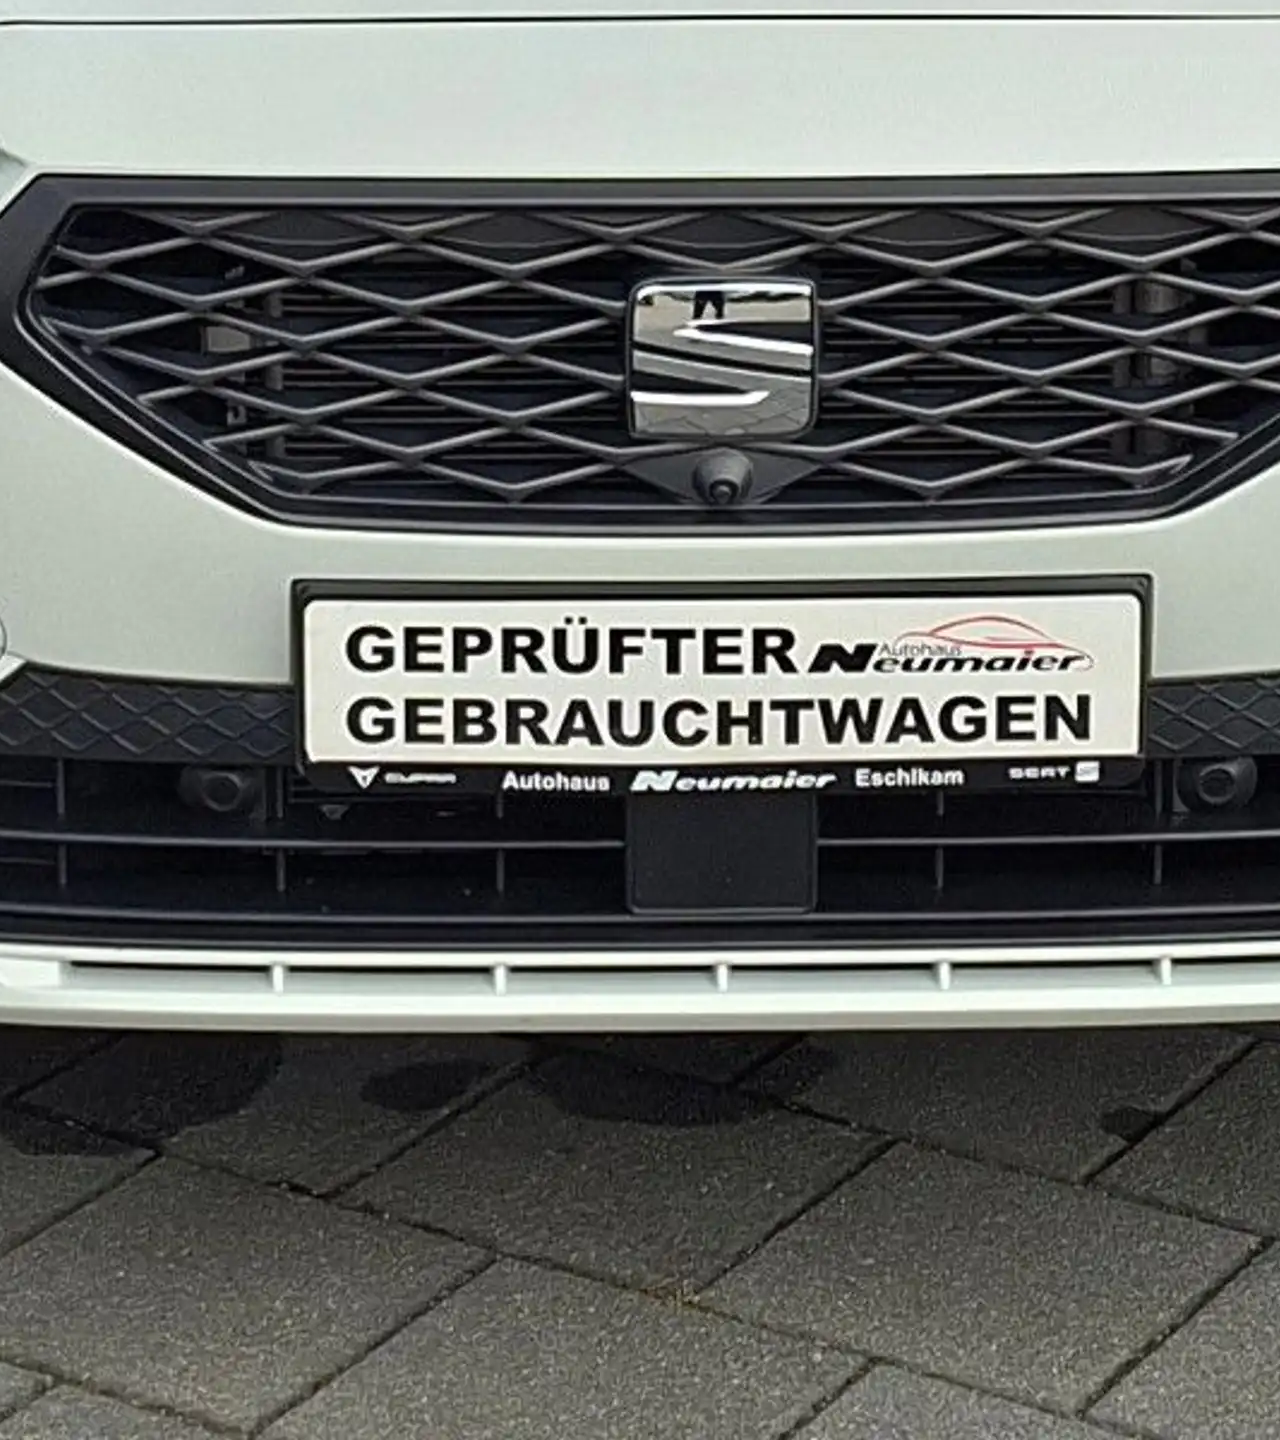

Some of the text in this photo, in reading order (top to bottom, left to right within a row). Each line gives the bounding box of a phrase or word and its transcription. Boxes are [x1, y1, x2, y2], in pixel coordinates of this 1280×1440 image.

[345, 616, 799, 675] GEPRÜFTER
[807, 642, 1084, 673] Neumaier
[878, 641, 963, 658] Autohaus
[345, 693, 1091, 747] GEBRAUCHTWAGEN
[501, 765, 965, 792] Autohaus Neumaier Eschlkam
